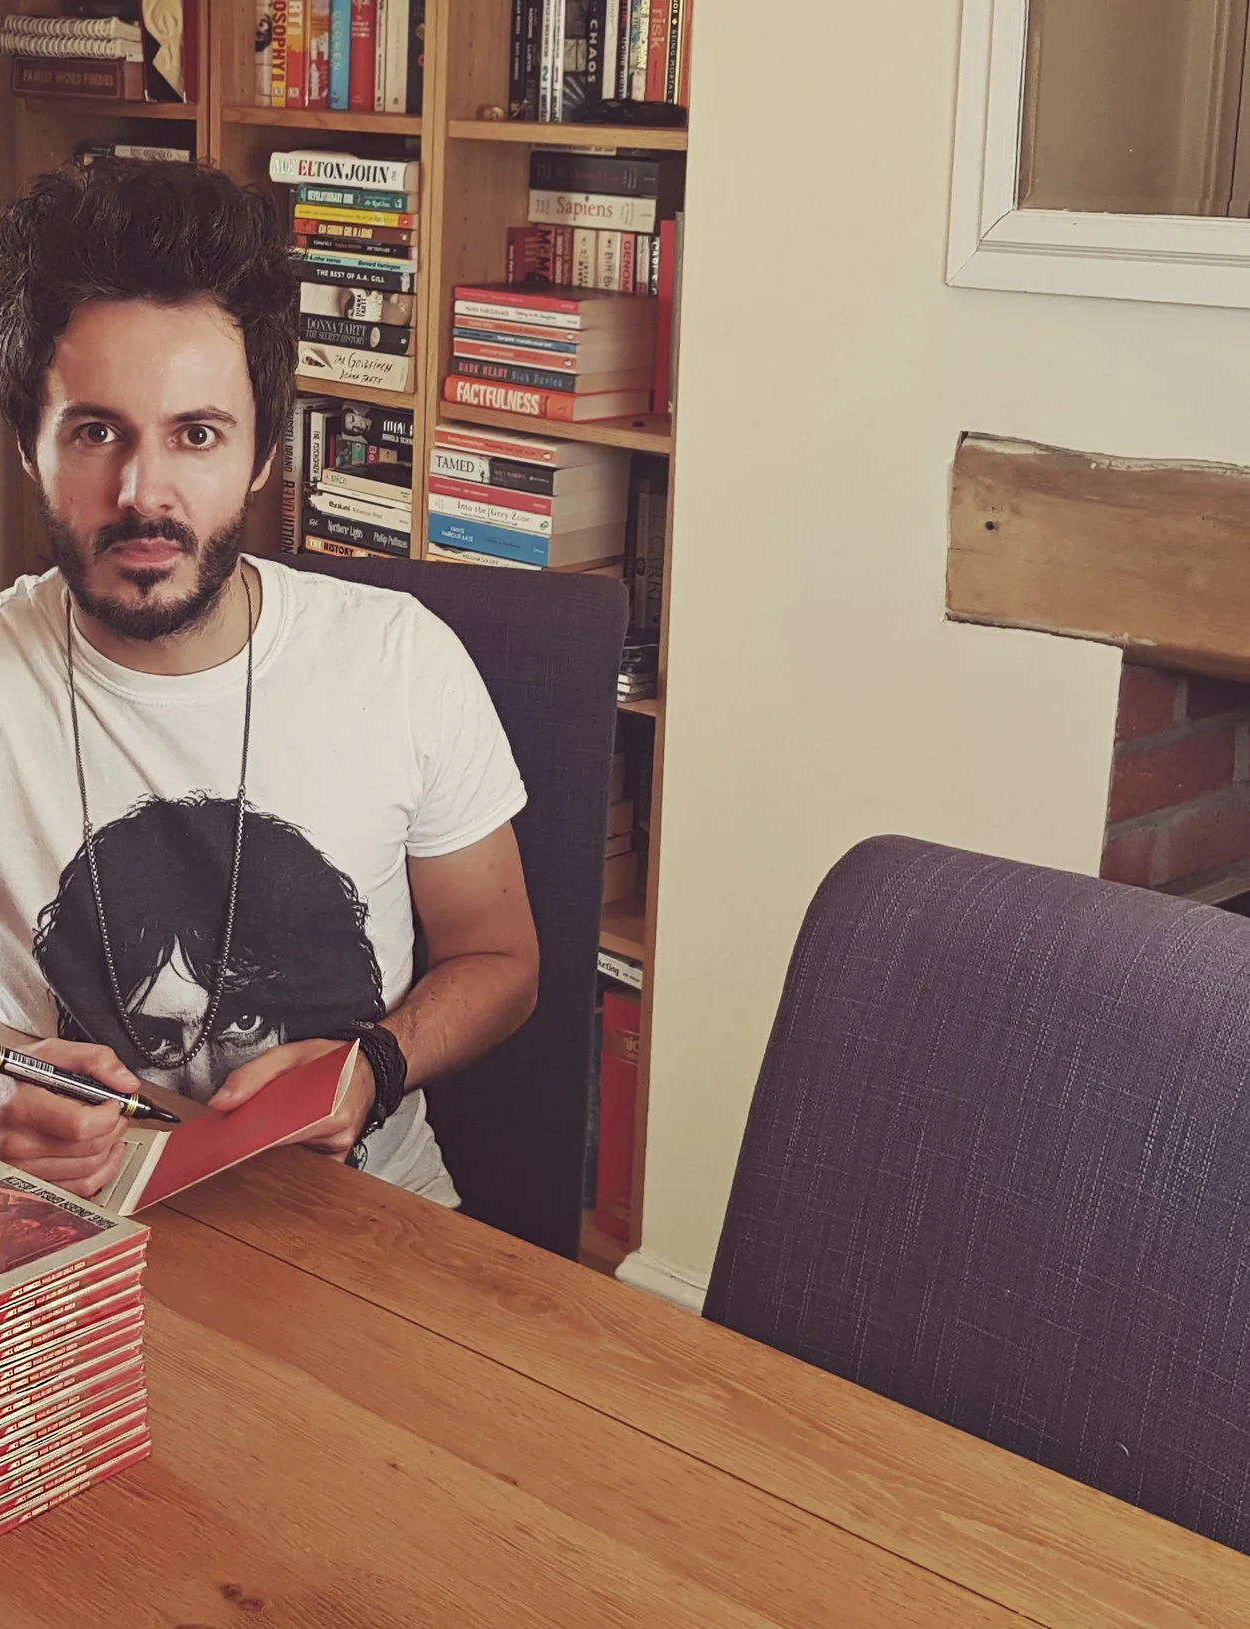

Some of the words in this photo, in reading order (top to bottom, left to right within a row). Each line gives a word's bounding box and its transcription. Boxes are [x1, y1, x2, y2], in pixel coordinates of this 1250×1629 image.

[651, 8, 666, 49] risk
[588, 19, 598, 83] CHAOS
[298, 159, 345, 180] ELTON
[346, 163, 389, 184] JOHN
[556, 196, 614, 221] Sapiens
[316, 268, 329, 277] THE
[330, 270, 344, 279] BEST
[346, 272, 355, 280] OF
[307, 318, 337, 333] DONNA
[338, 322, 367, 337] TARTT
[483, 365, 508, 379] HEART
[456, 381, 541, 416] FACTFULNESS
[435, 454, 474, 473] TAMED
[474, 504, 487, 514] the
[490, 508, 508, 521] Grey
[323, 541, 354, 556] HISTORY
[31, 1187, 66, 1205] GREAT
[59, 1201, 95, 1218] ANGER
